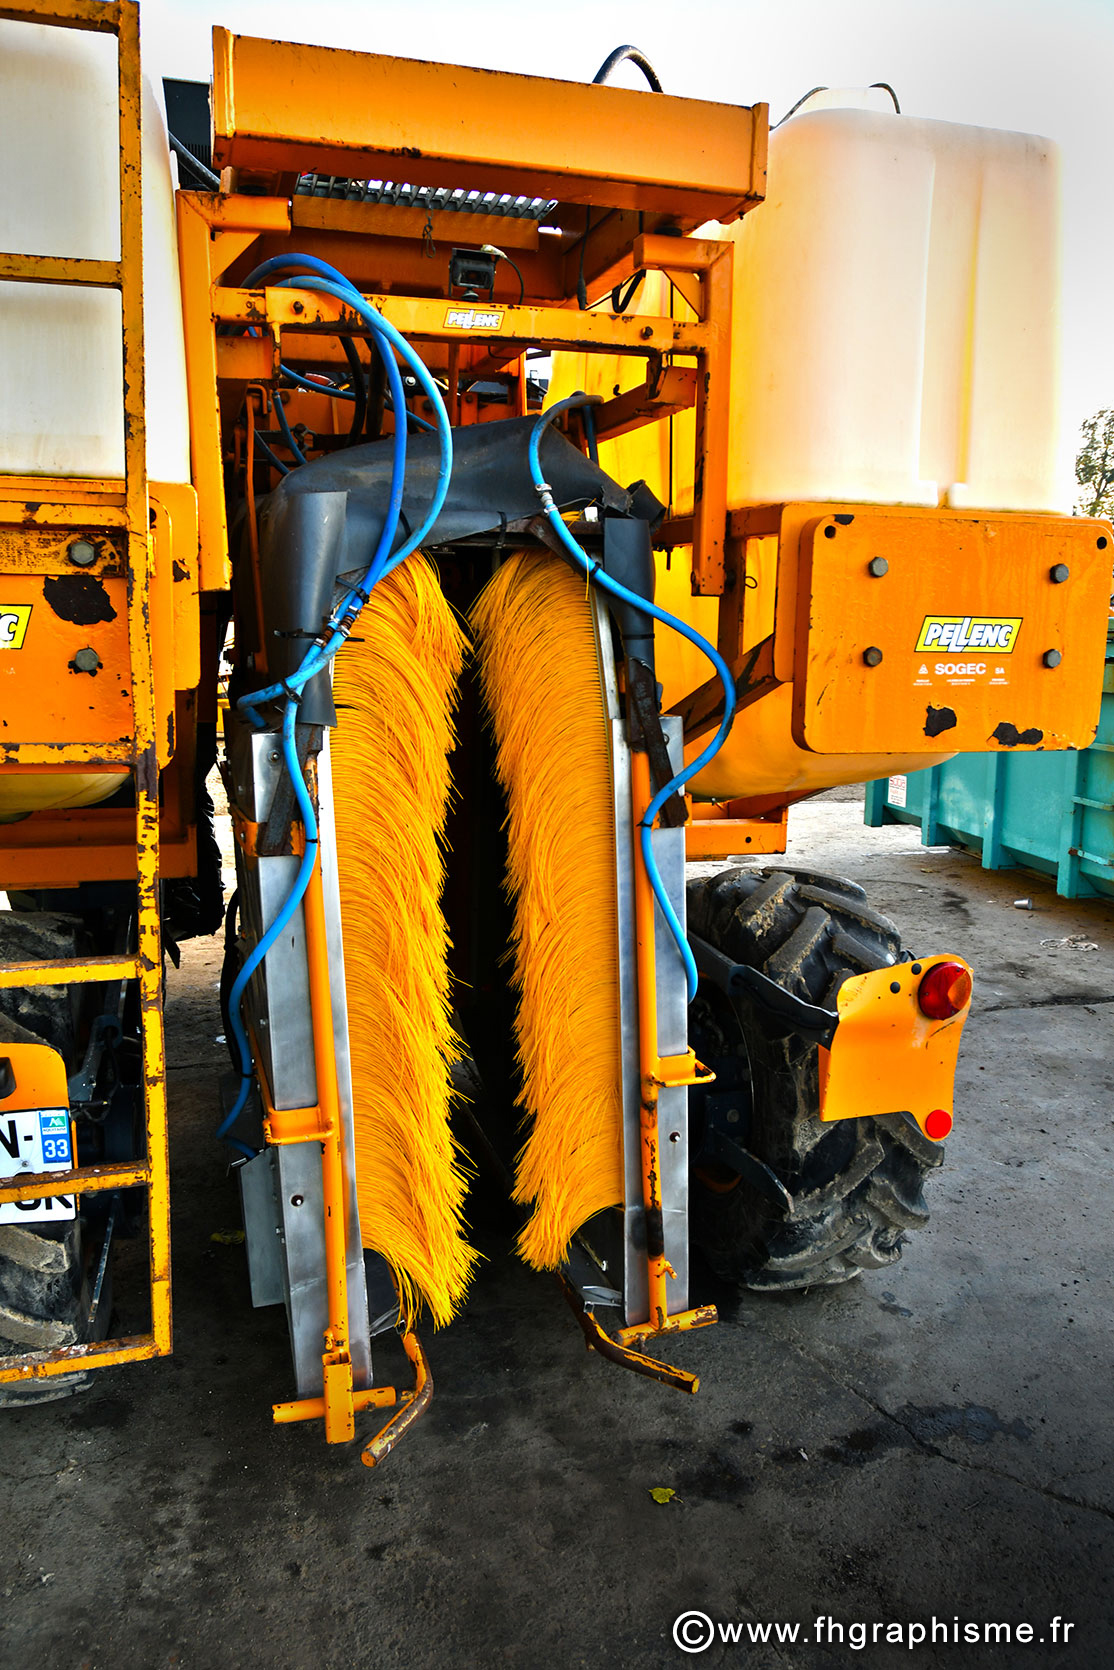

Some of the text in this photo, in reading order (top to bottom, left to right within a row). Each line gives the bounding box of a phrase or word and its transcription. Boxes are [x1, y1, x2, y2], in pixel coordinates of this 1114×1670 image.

[447, 309, 501, 329] PELLENC
[923, 617, 1013, 652] PELLENC
[935, 663, 987, 675] SOGEC
[44, 1139, 69, 1158] 33
